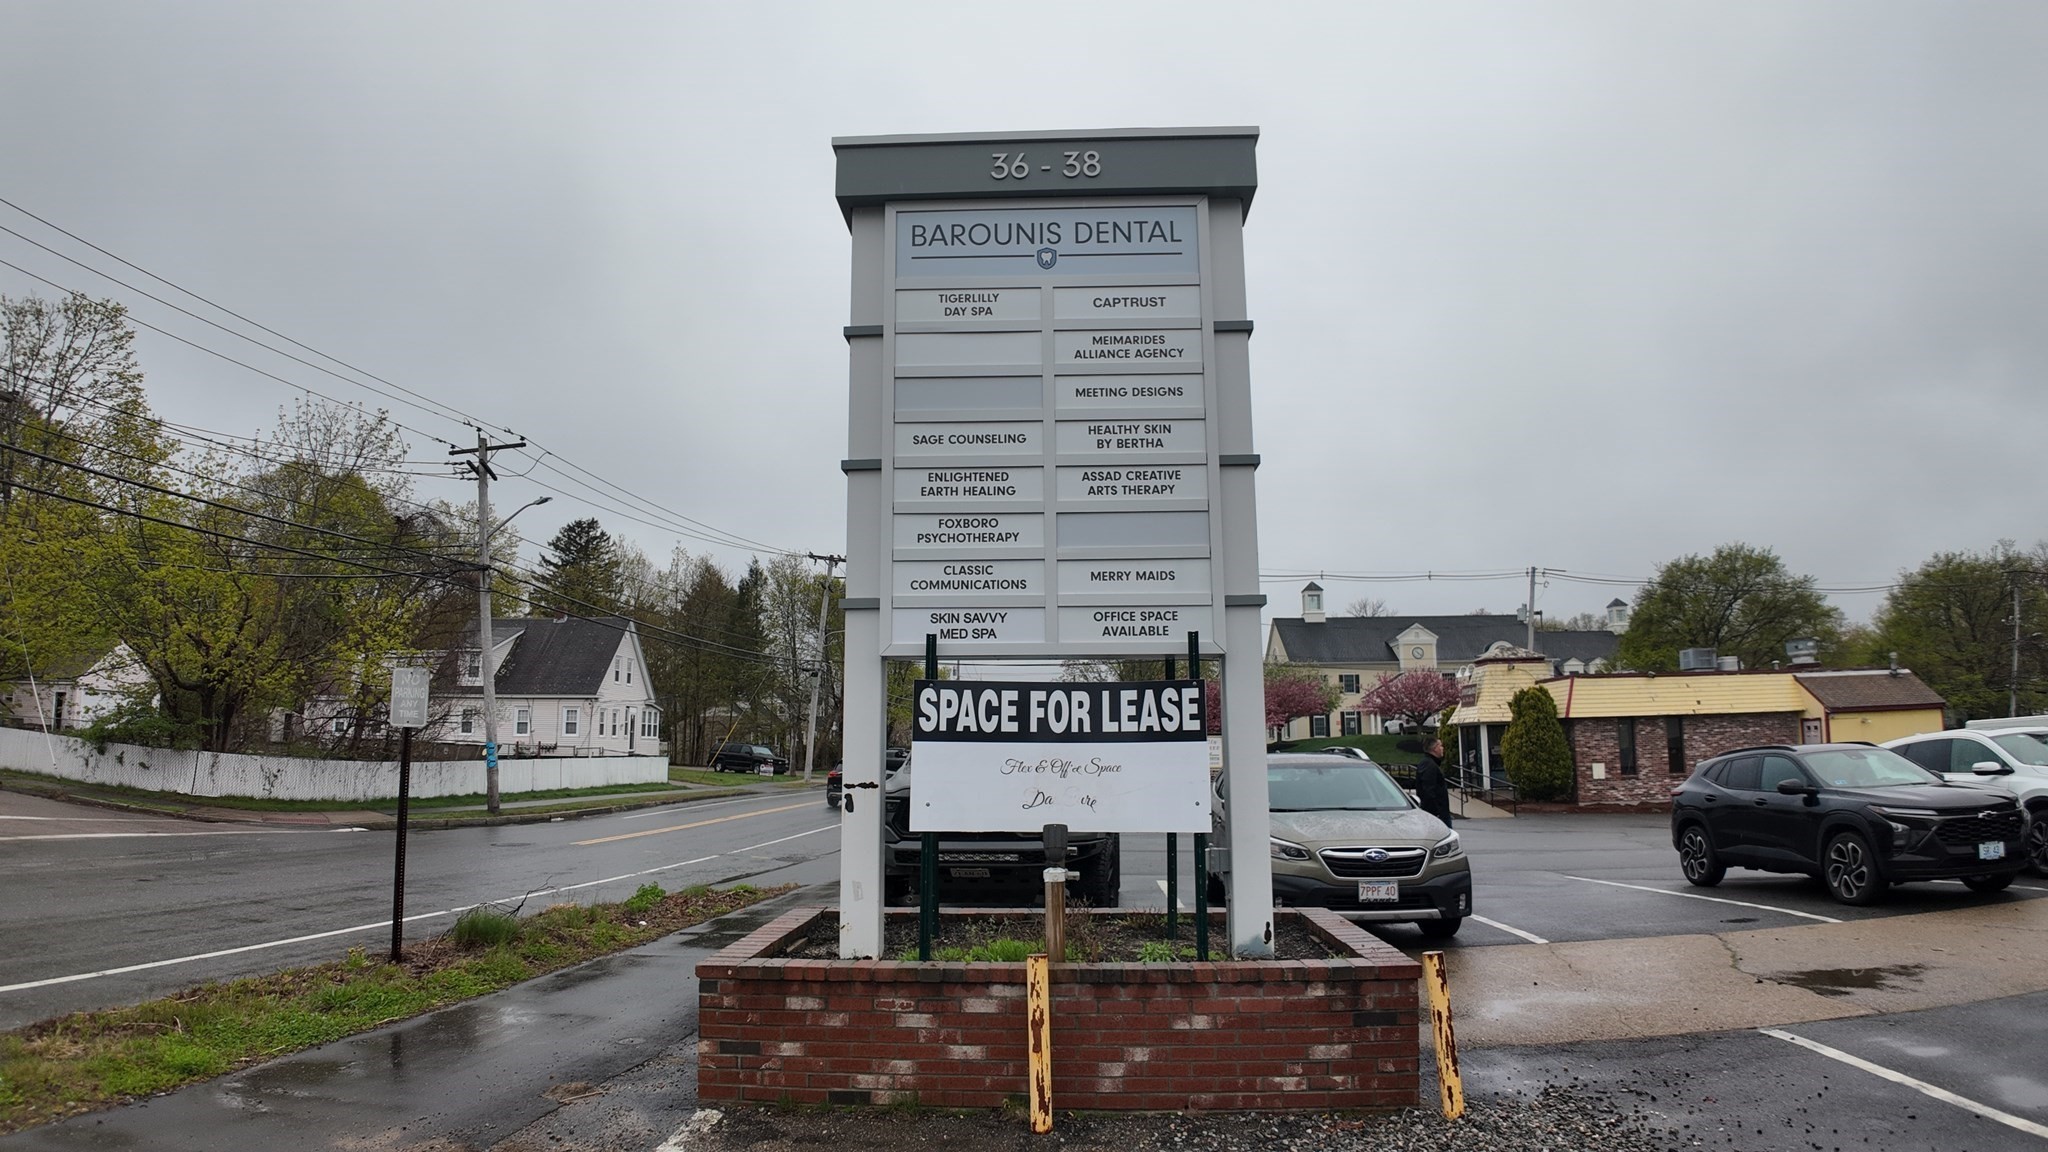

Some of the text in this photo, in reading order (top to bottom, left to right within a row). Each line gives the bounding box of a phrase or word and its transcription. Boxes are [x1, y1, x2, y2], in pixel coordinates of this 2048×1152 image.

[990, 152, 1030, 180] 36
[1062, 150, 1102, 178] 38
[912, 221, 1182, 247] BAROUNIS DENTAL
[939, 294, 999, 303] TIGERLILLY
[1093, 297, 1166, 307] CAPTRUST
[945, 307, 992, 316] DAY SPA
[1093, 335, 1165, 345] MEIMARIDES
[1074, 349, 1184, 359] ALLIANCE AGENCY
[1076, 387, 1183, 397] MEETING DESIGNS
[1089, 424, 1171, 435] HEALTHY SKIN
[913, 434, 1026, 444] SAGE COUNSELING
[1097, 438, 1163, 448] BY BERTHA
[928, 472, 1009, 482] ENLIGHTENED
[1082, 470, 1181, 481] ASSAD CREATIVE
[921, 486, 1016, 496] EARTH HEALING
[1088, 485, 1175, 495] ARTS THERAPY
[939, 518, 998, 528] FOXBORO
[918, 532, 1019, 543] PSYCHOTHERAPY
[944, 565, 993, 575] CLASSIC
[1091, 571, 1175, 581] MERRY MAIDS
[911, 580, 1026, 590] COMMUNICATIONS
[930, 613, 1007, 624] SKIN SAVVY
[1094, 611, 1178, 621] OFFICE SPACE
[940, 628, 997, 639] MED SPA
[1102, 626, 1168, 636] AVAILABLE
[401, 675, 421, 686] NO
[394, 688, 426, 698] PARKING
[400, 700, 418, 708] ANY
[399, 710, 419, 718] TIME
[919, 688, 1200, 733] SPACE FOR LEASE
[1035, 759, 1049, 774] &
[1084, 757, 1122, 777] Space
[1384, 885, 1396, 896] 40
